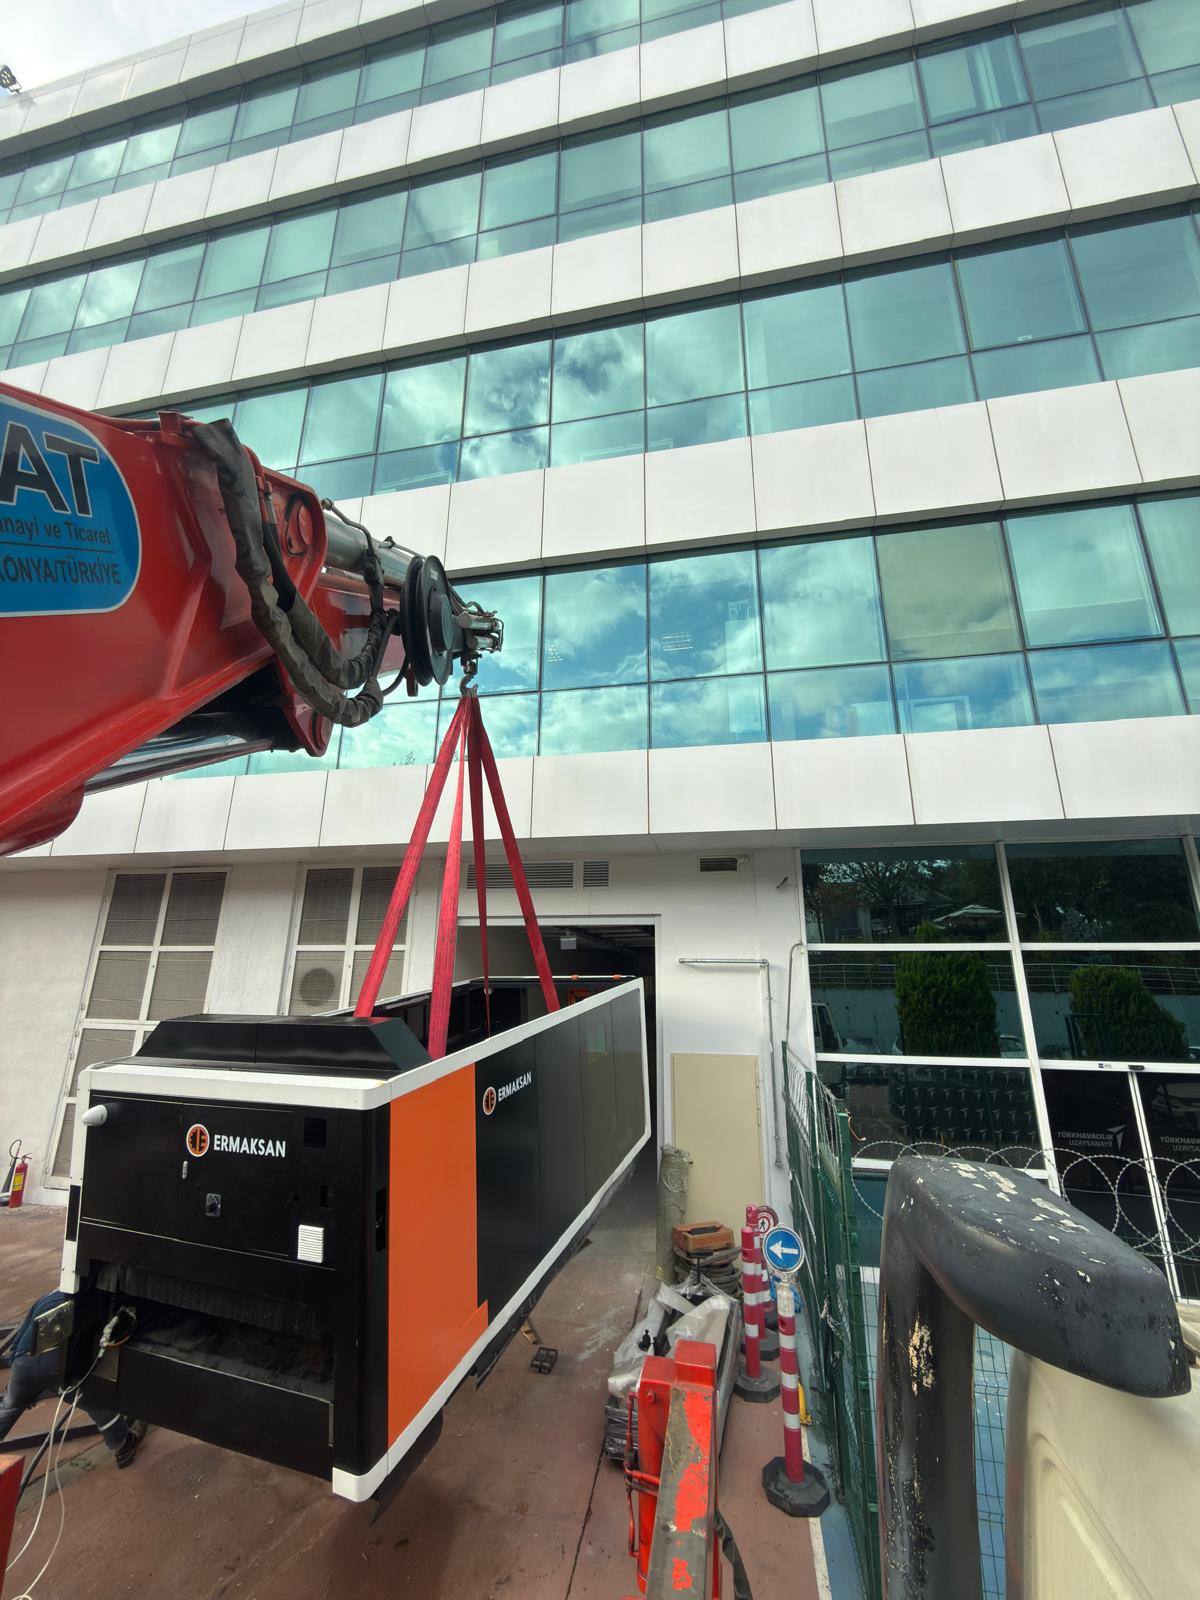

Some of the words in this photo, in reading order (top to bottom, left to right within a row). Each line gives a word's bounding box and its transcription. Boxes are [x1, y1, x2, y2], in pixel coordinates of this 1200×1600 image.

[43, 523, 61, 539] ve
[64, 521, 112, 545] Ticaret
[498, 1071, 532, 1102] ERMAKSAN
[213, 1134, 286, 1158] ERMAKSAN
